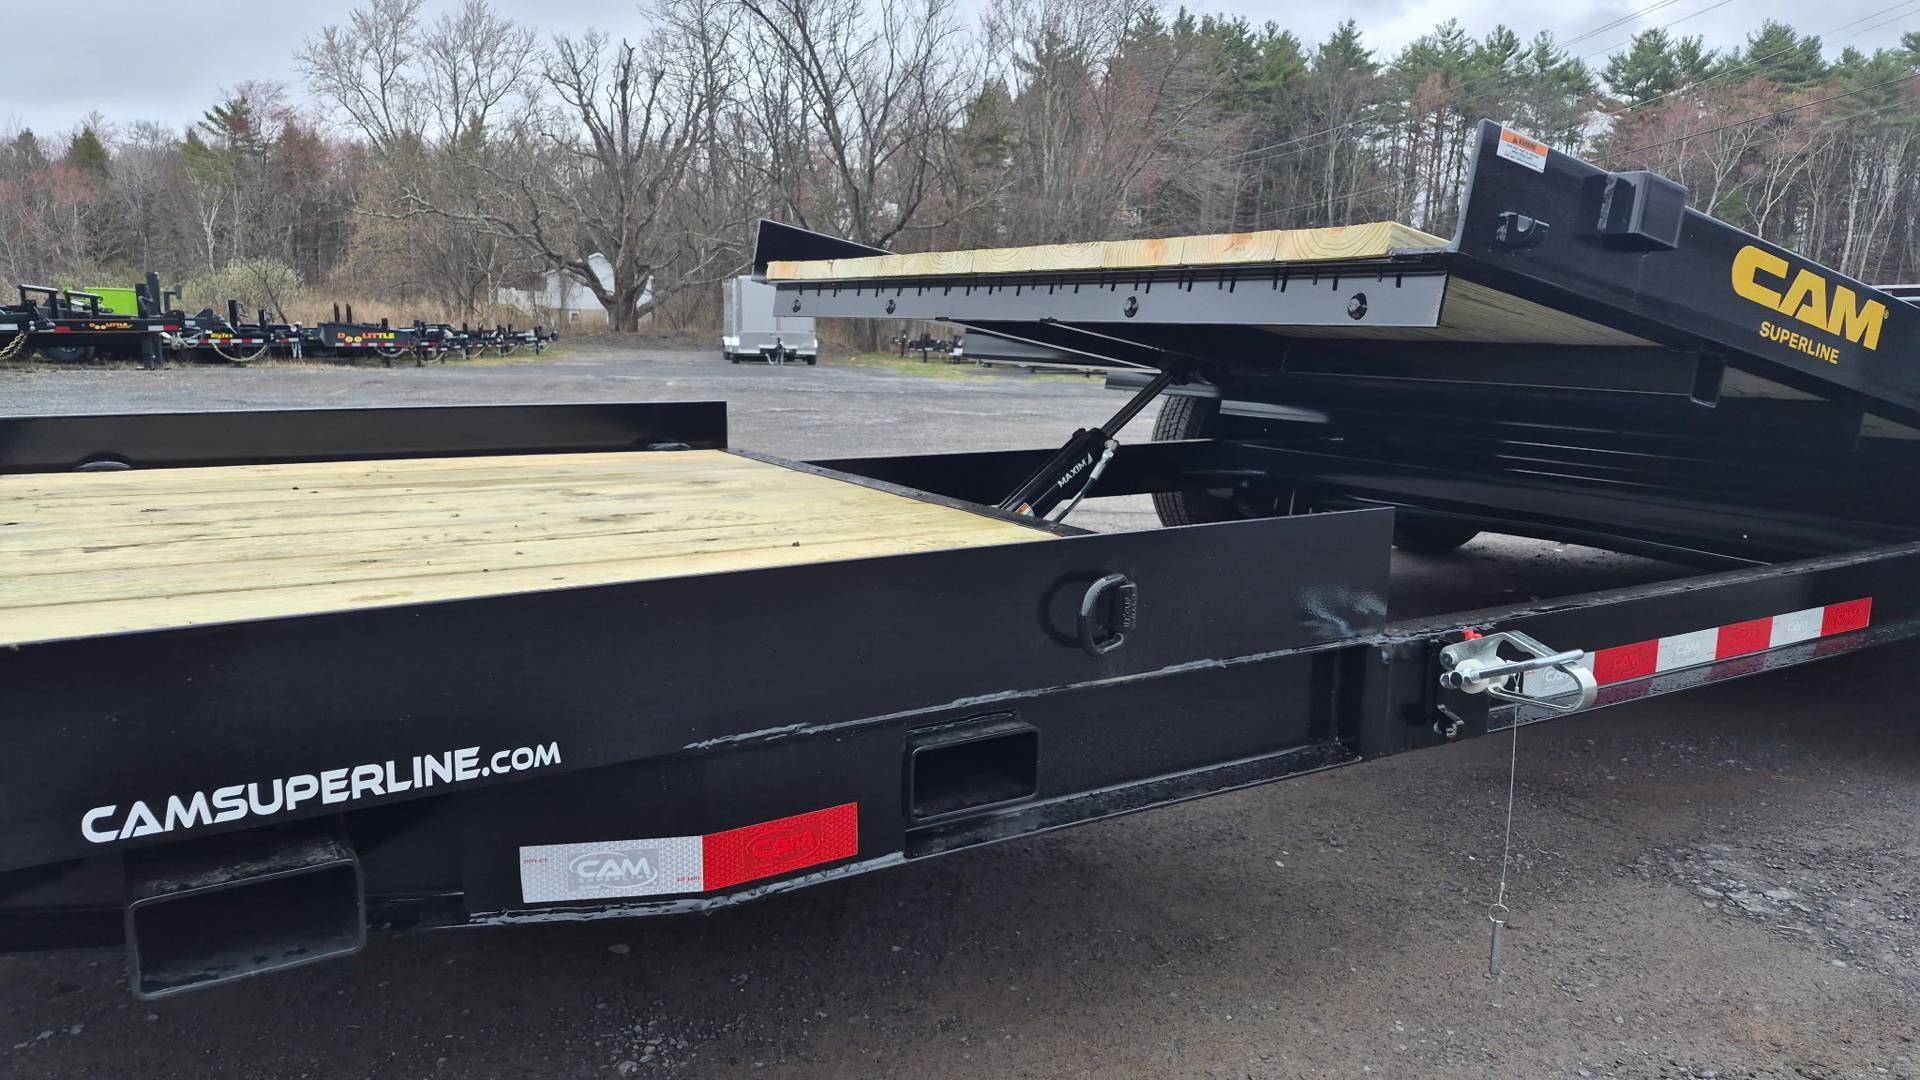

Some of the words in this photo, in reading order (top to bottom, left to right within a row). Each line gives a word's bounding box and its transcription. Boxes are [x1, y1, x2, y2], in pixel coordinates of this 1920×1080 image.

[1732, 245, 1886, 351] CAM
[1759, 320, 1840, 365] SUPERLINE
[1057, 459, 1088, 488] MAXIM
[1676, 639, 1701, 654] CAM
[81, 741, 561, 844] CAMSUPERLINE.COM
[577, 857, 652, 878] CAM
